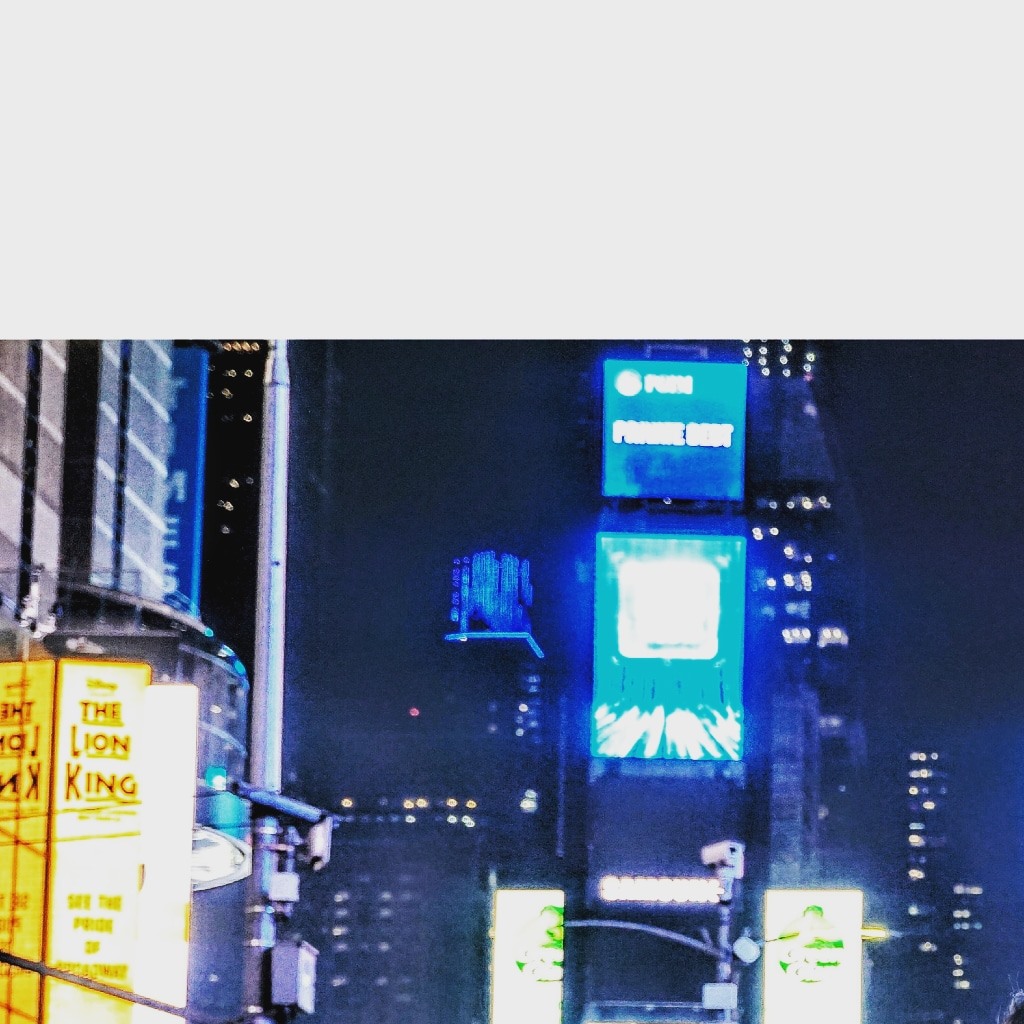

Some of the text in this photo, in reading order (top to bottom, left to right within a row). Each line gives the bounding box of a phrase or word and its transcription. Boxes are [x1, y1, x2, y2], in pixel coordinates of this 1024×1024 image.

[80, 701, 122, 720] THE
[71, 725, 130, 757] LION
[66, 762, 138, 801] KING
[67, 892, 123, 912] SEE THE
